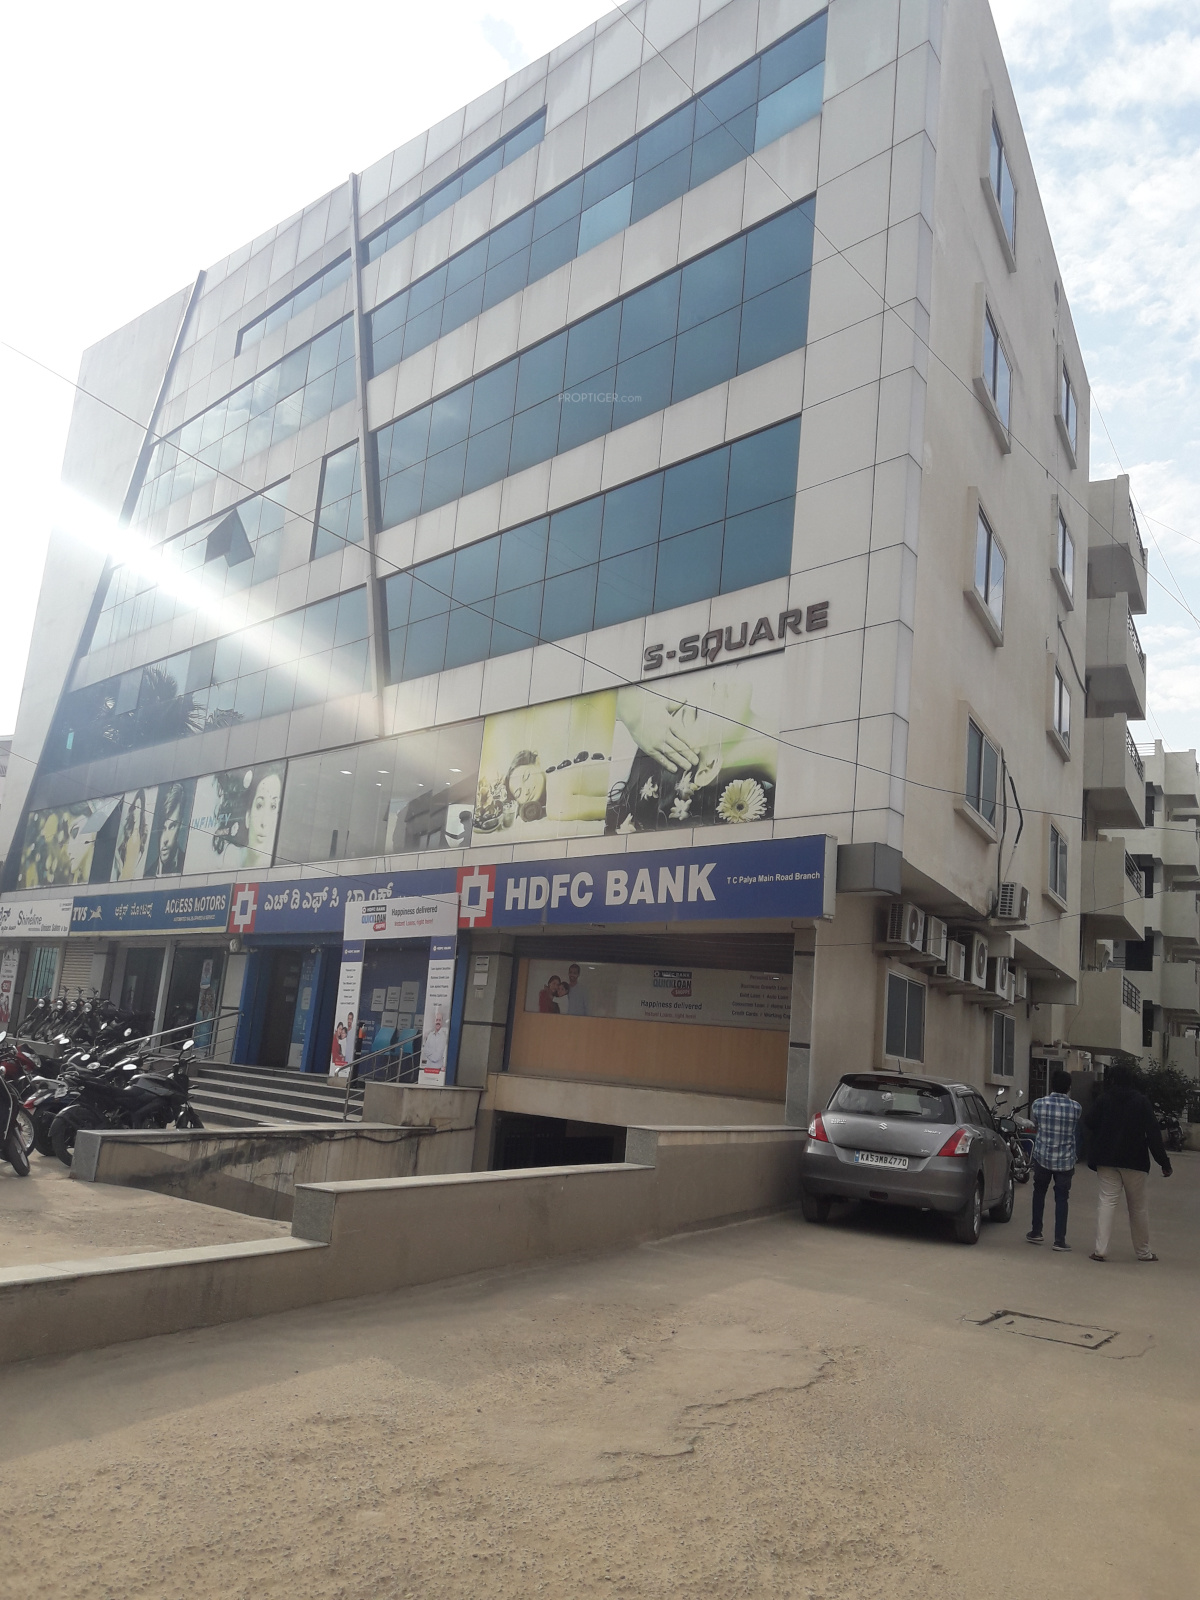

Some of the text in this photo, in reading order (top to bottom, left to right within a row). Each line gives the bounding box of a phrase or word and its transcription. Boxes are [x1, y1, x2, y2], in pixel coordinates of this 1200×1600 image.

[643, 600, 830, 672] S-SQUARE
[738, 875, 757, 885] Palya
[758, 874, 774, 882] Main
[775, 872, 794, 881] Road
[795, 871, 820, 880] Branch
[505, 862, 717, 911] HDFC BANK
[165, 895, 226, 914] ACCESS MOTORS
[392, 905, 437, 917] Happiness delivered
[72, 906, 88, 921] TVS
[641, 1000, 702, 1010] Happiness delivered
[860, 1153, 907, 1167] KA53MB4770
